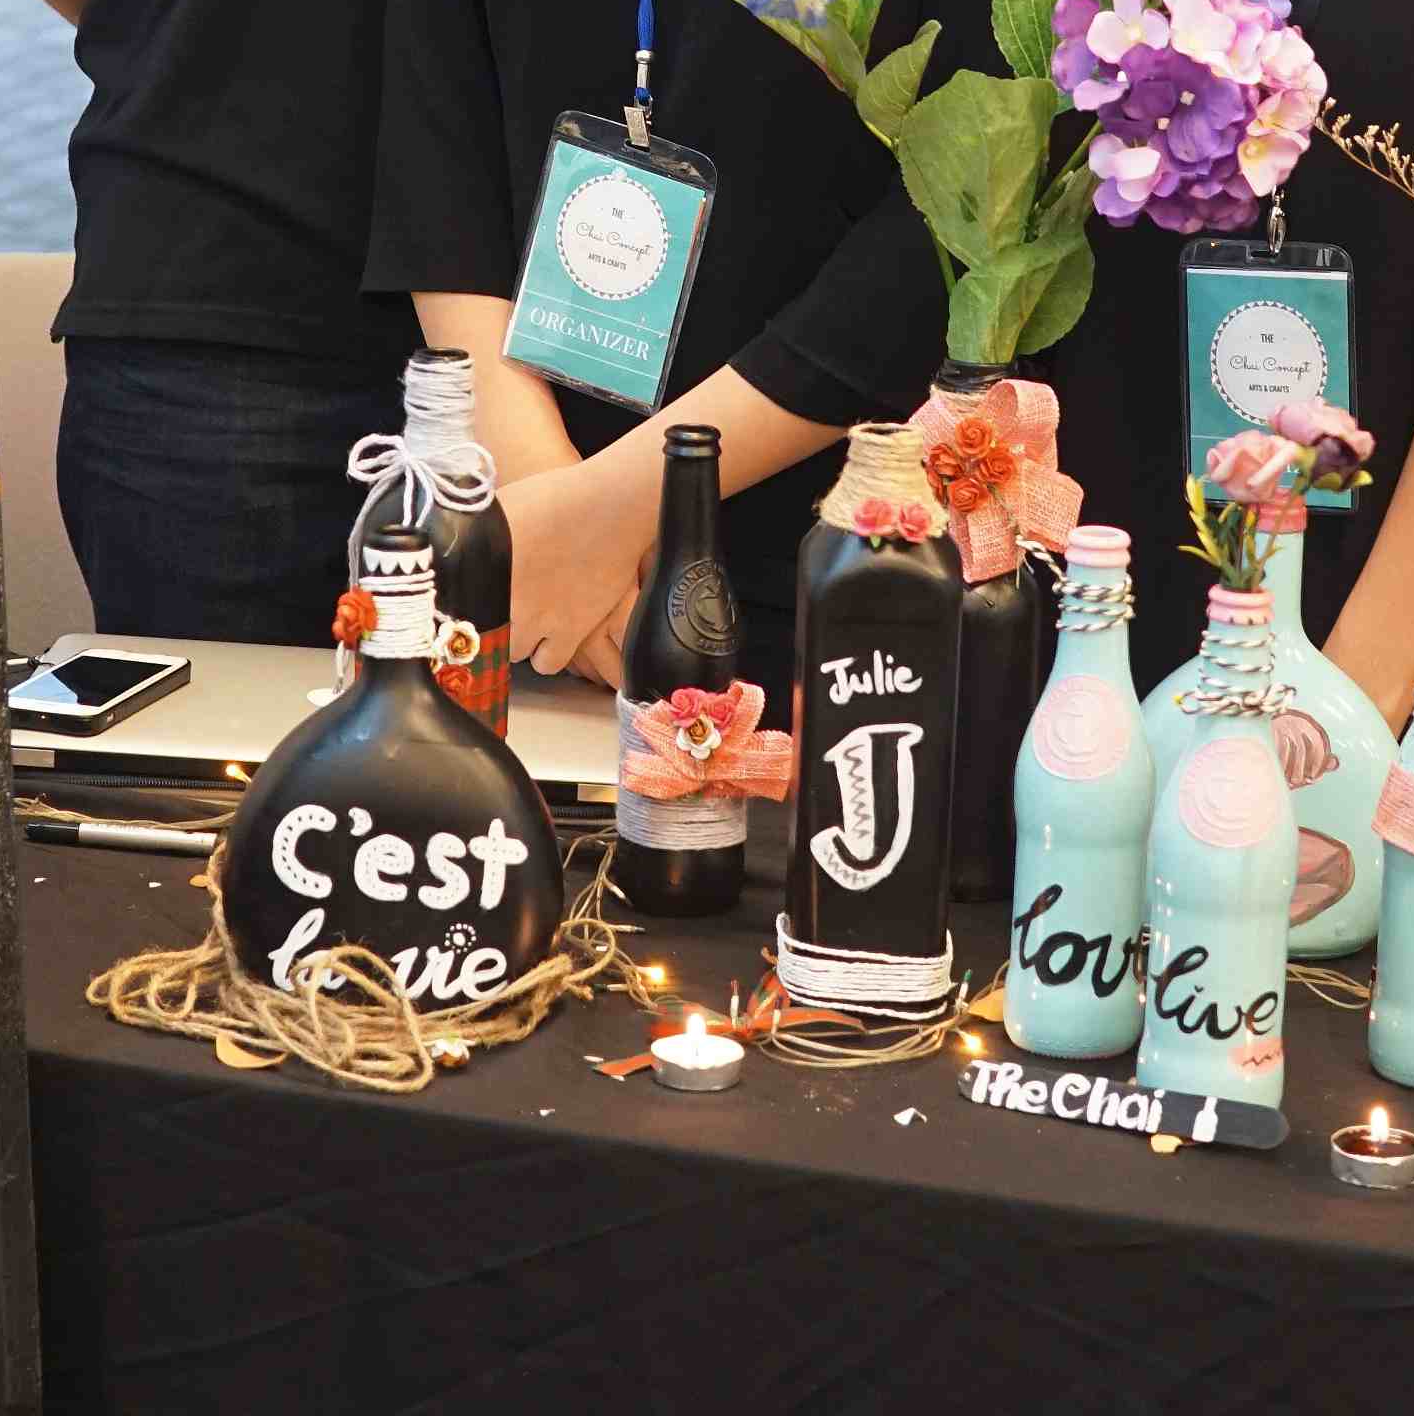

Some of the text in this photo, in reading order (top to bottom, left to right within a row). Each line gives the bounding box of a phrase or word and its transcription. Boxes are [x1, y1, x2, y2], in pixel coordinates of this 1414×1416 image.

[530, 306, 651, 361] ORGANIZER
[1260, 332, 1275, 344] THE
[820, 649, 924, 705] Julie
[809, 722, 924, 891] J
[271, 803, 529, 911] C'est
[1014, 884, 1147, 998] lov
[1150, 945, 1279, 1040] live
[970, 1059, 1166, 1134] The Chai
